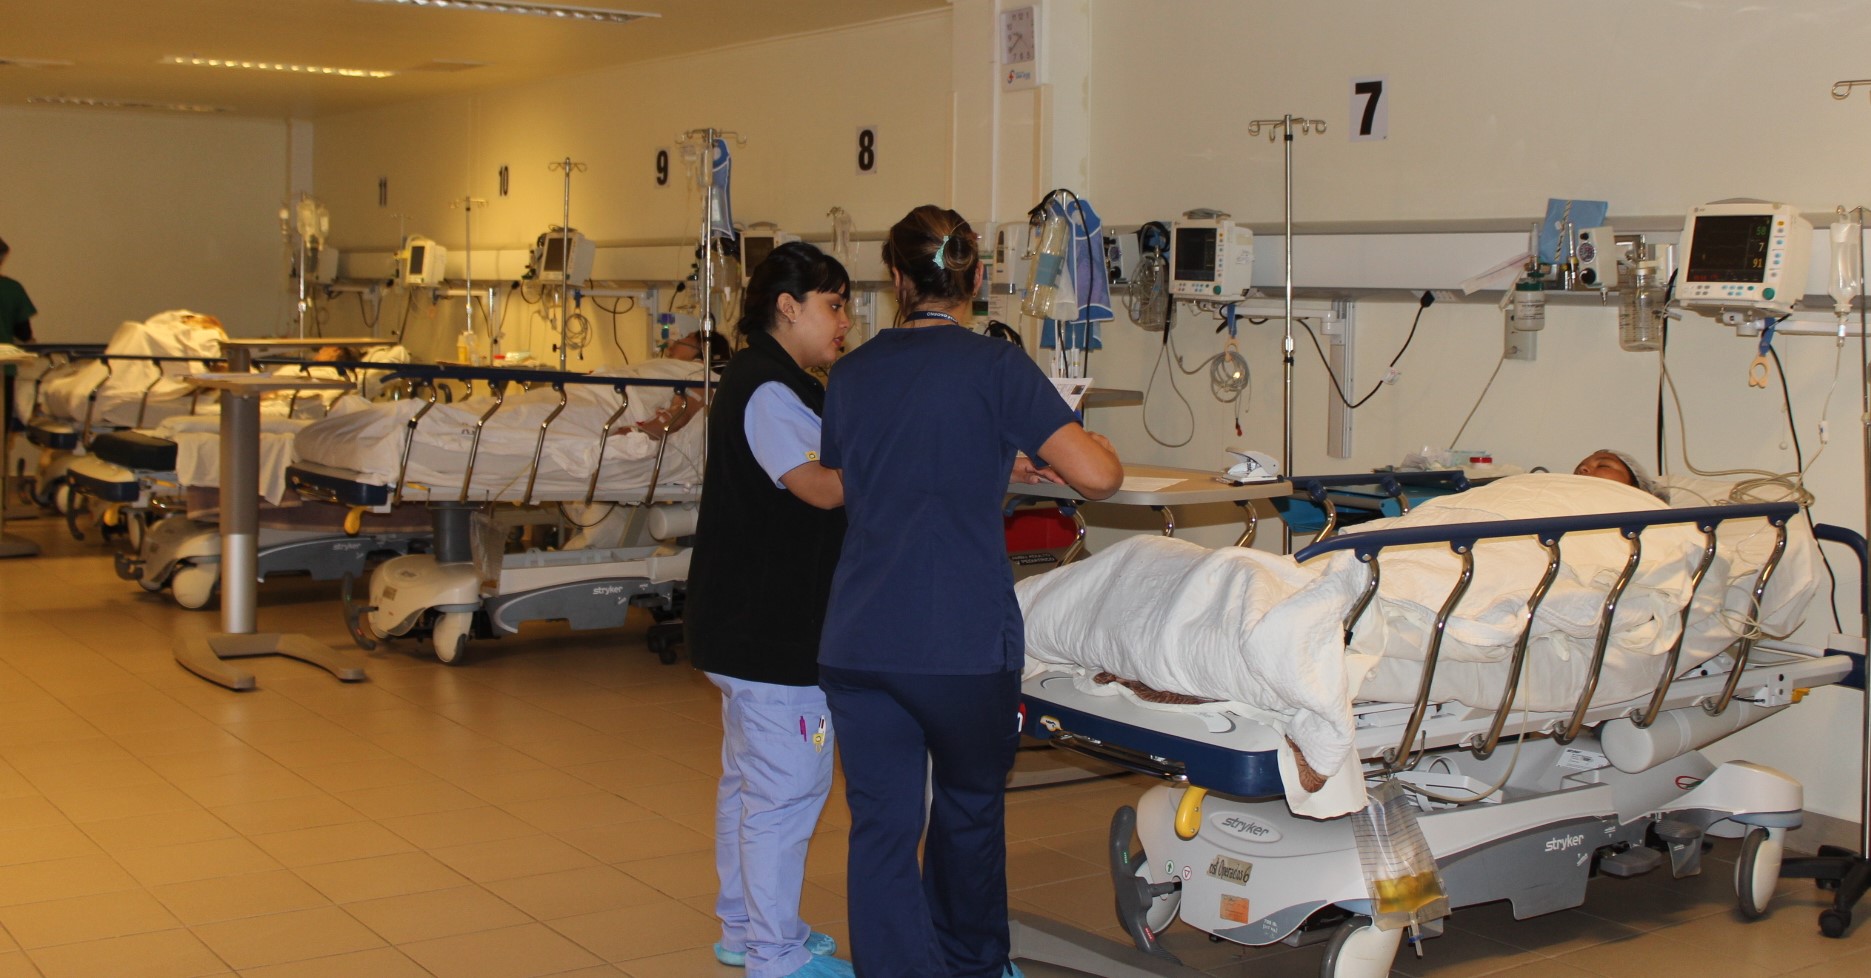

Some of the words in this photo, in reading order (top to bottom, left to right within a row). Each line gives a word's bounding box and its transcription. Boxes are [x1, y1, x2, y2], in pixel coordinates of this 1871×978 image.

[1355, 80, 1383, 136] 7
[858, 129, 875, 172] 8
[656, 150, 669, 186] 9
[378, 177, 388, 207] 11
[498, 165, 509, 197] 10
[1759, 242, 1765, 252] 7
[1752, 258, 1763, 268] 91
[593, 586, 623, 595] stryker
[1222, 817, 1269, 836] stryker
[1545, 835, 1583, 852] stryker
